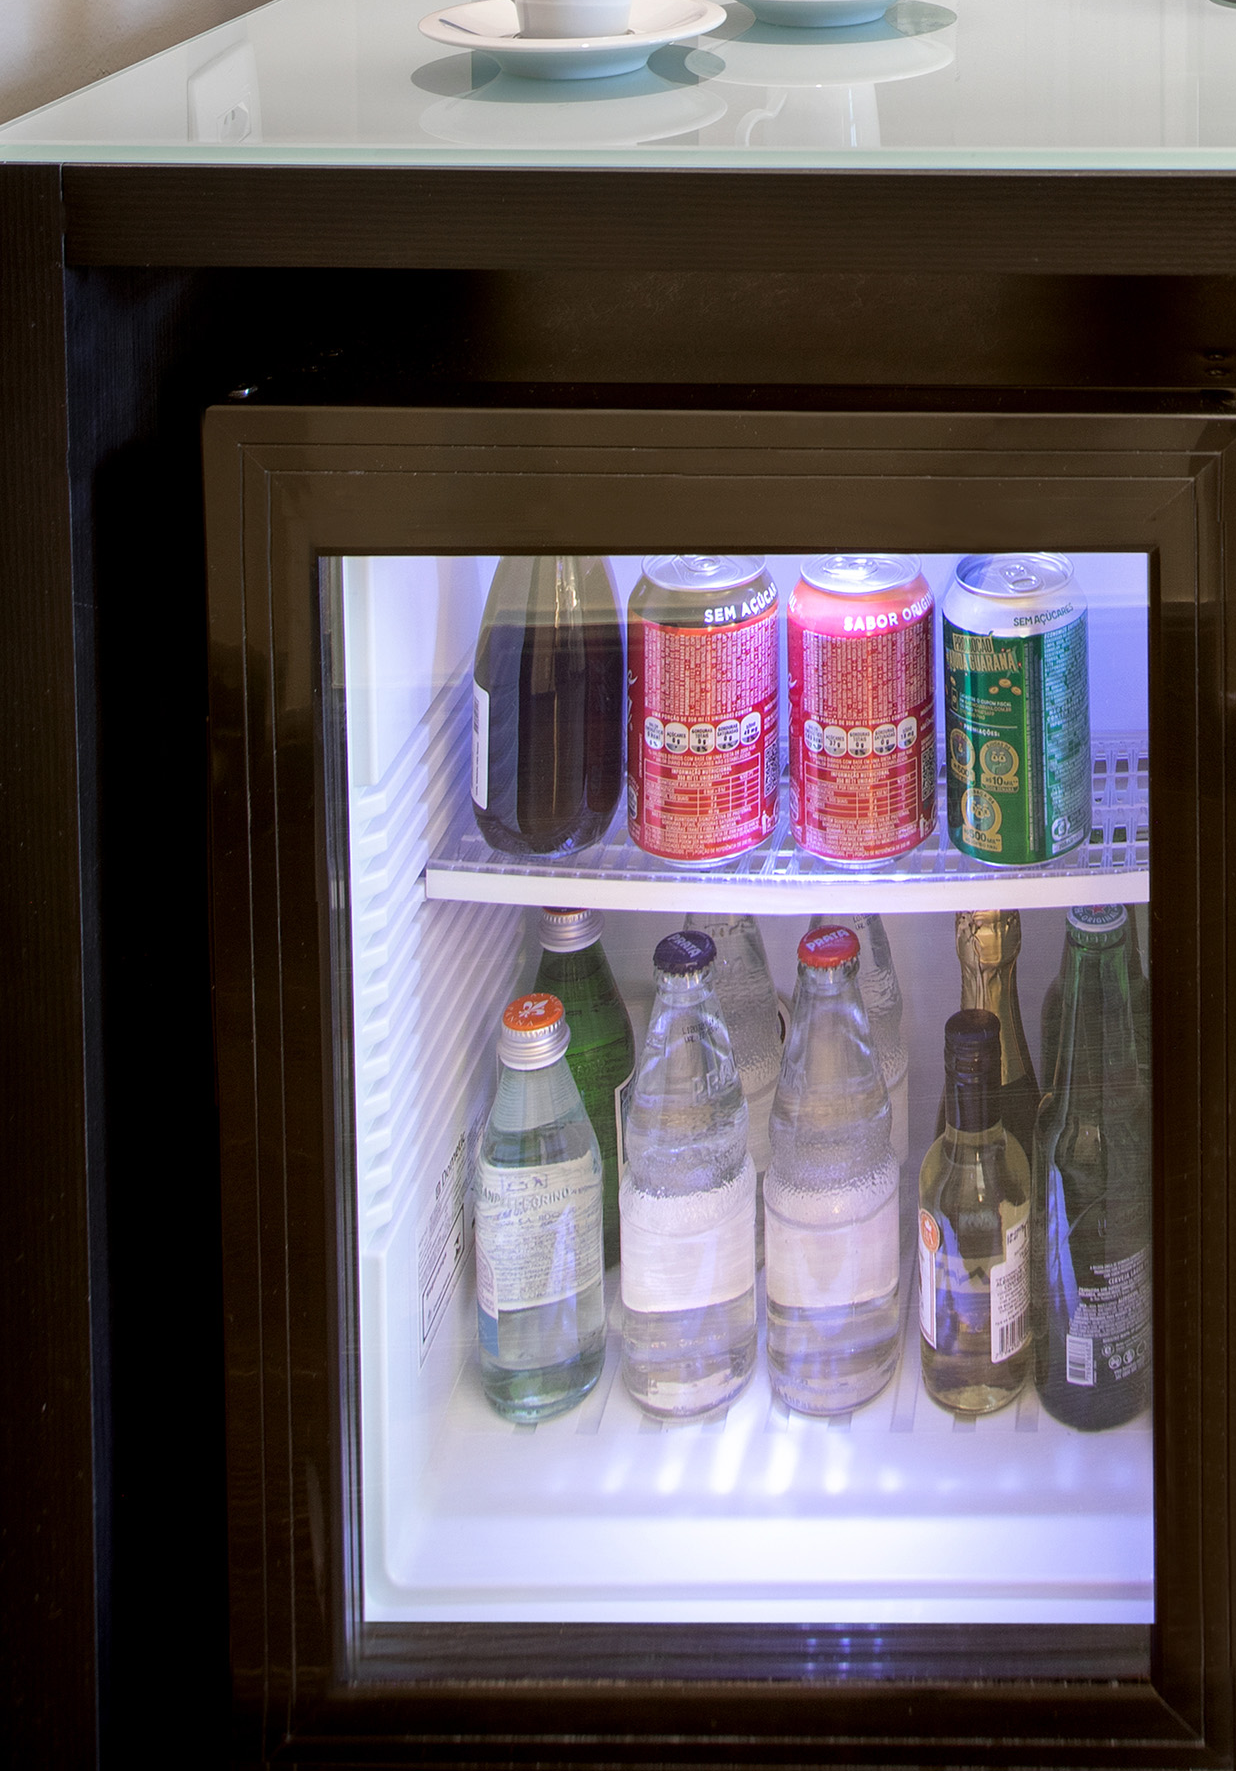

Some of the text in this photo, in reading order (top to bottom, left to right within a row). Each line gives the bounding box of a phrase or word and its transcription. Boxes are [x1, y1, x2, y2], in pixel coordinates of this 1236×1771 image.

[704, 604, 737, 623] SEM
[843, 612, 899, 632] SABOR
[1013, 602, 1074, 627] SEM AÇÚCARES
[969, 648, 1018, 672] GUARANÁ
[667, 933, 702, 958] PRATA
[806, 929, 850, 952] PRATA
